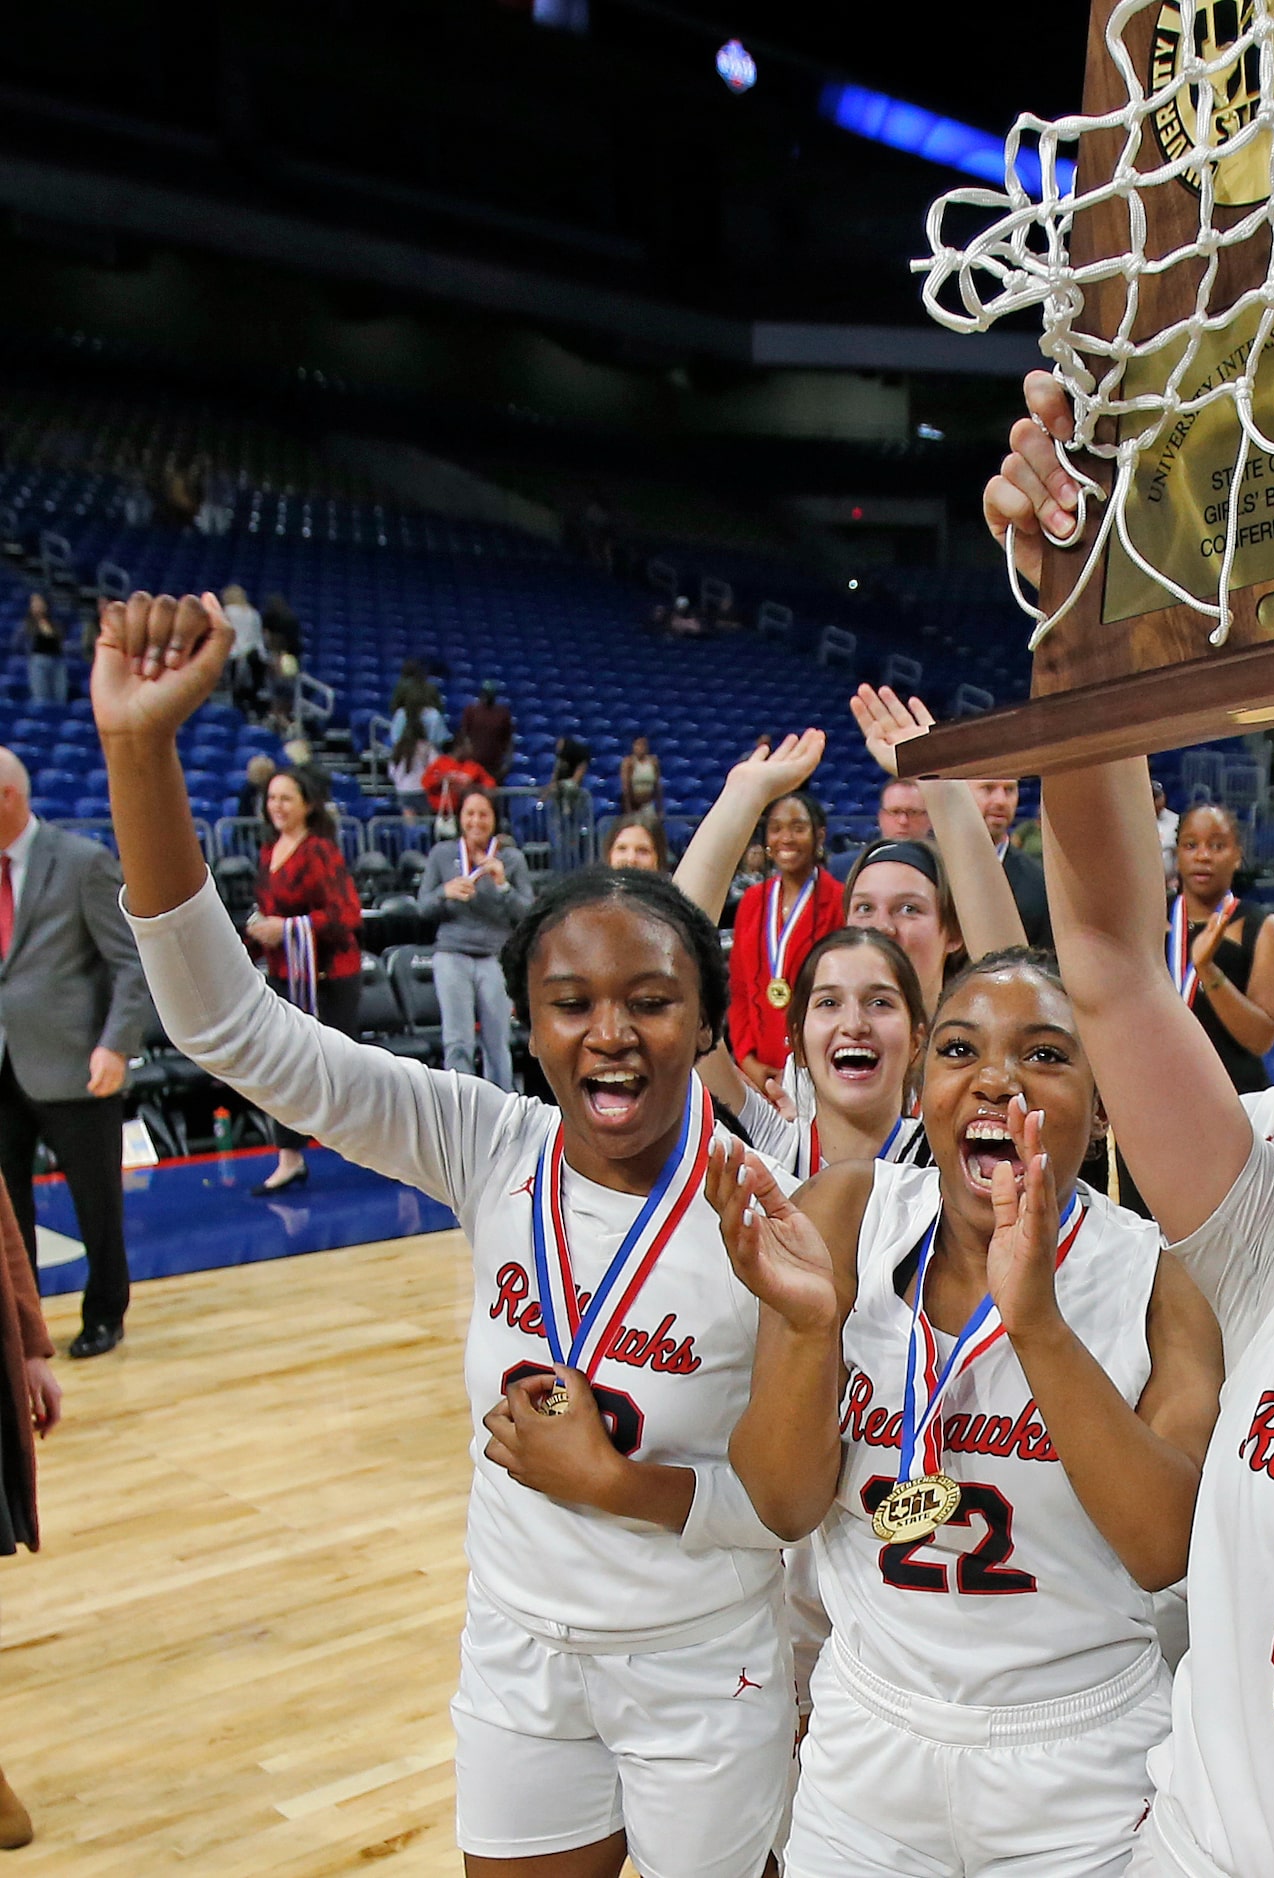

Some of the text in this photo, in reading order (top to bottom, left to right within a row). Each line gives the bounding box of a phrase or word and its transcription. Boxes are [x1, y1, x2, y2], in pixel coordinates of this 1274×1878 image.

[1148, 375, 1213, 503] UNIVERSY
[1212, 457, 1264, 491] STTE
[888, 1488, 941, 1522] UIL
[896, 1512, 932, 1528] STATE
[860, 1475, 1038, 1594] 22
